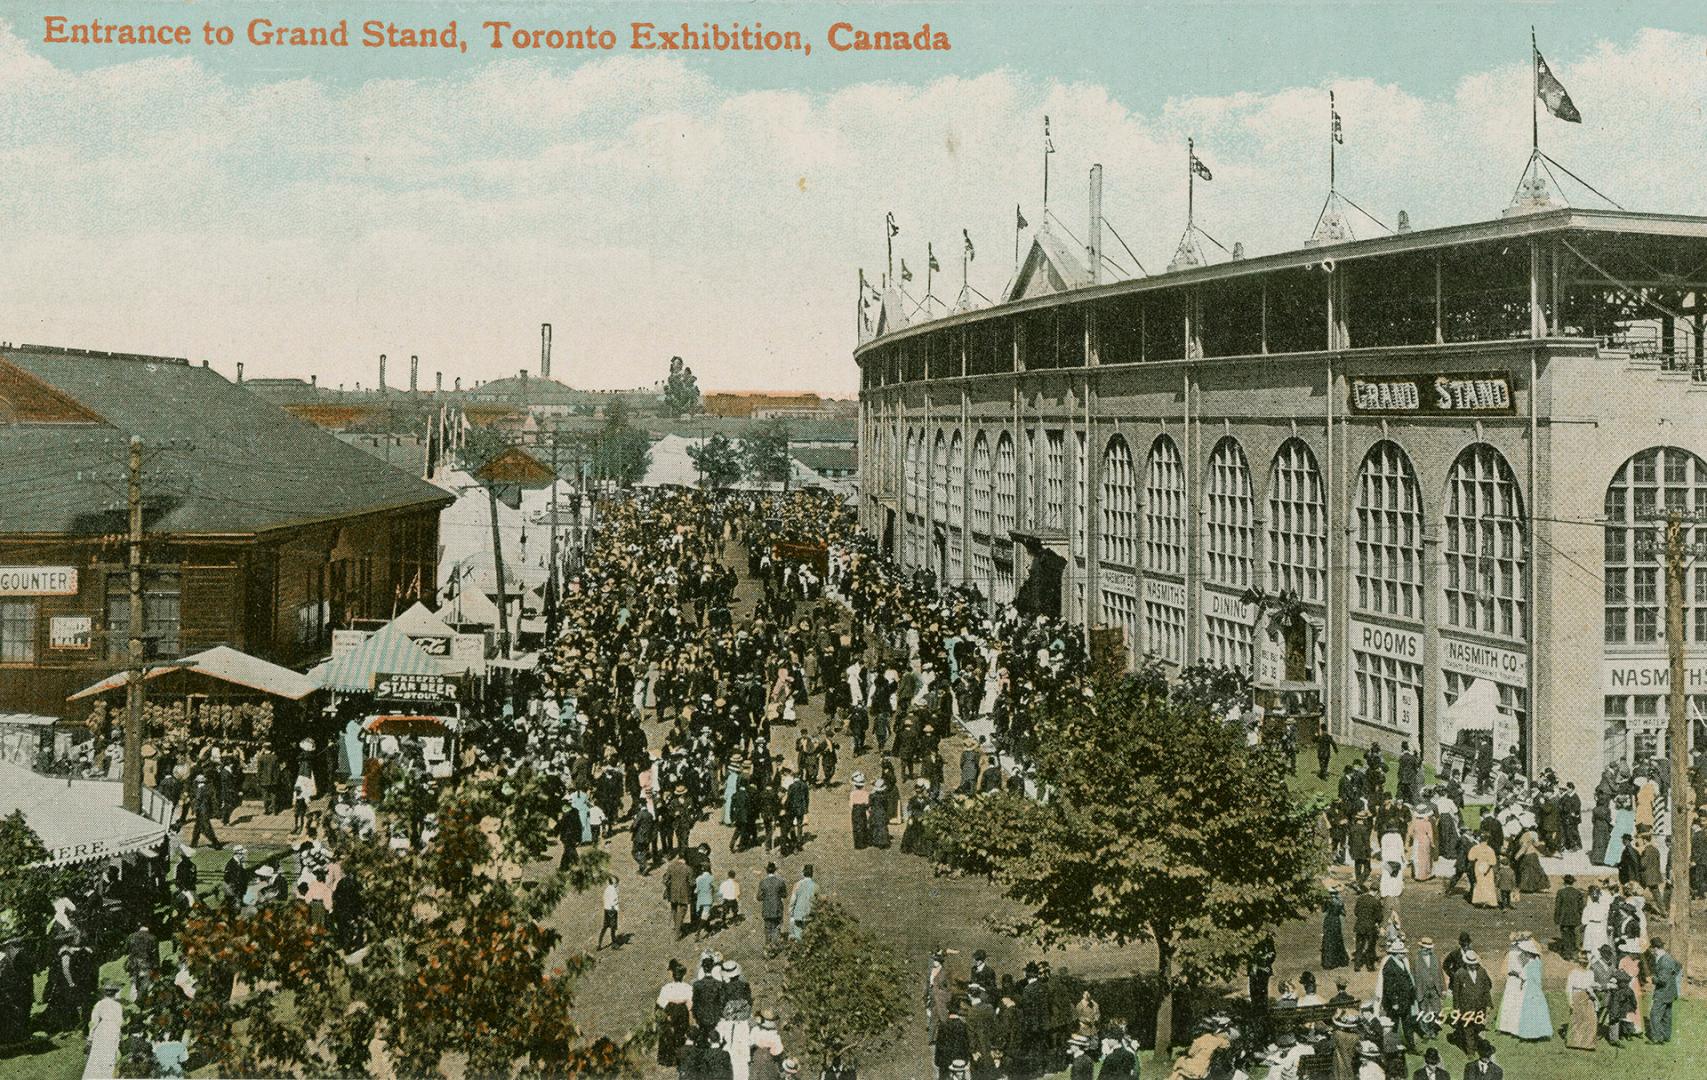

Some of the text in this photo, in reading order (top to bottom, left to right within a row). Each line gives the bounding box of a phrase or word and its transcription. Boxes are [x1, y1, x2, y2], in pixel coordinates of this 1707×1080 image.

[1352, 376, 1510, 410] GRAND STAND
[1, 572, 68, 590] COUNTER
[1212, 595, 1248, 620] DINING
[1362, 626, 1417, 657] ROOMS
[1449, 642, 1499, 669] NASMITH
[377, 681, 457, 699] STAR BEER
